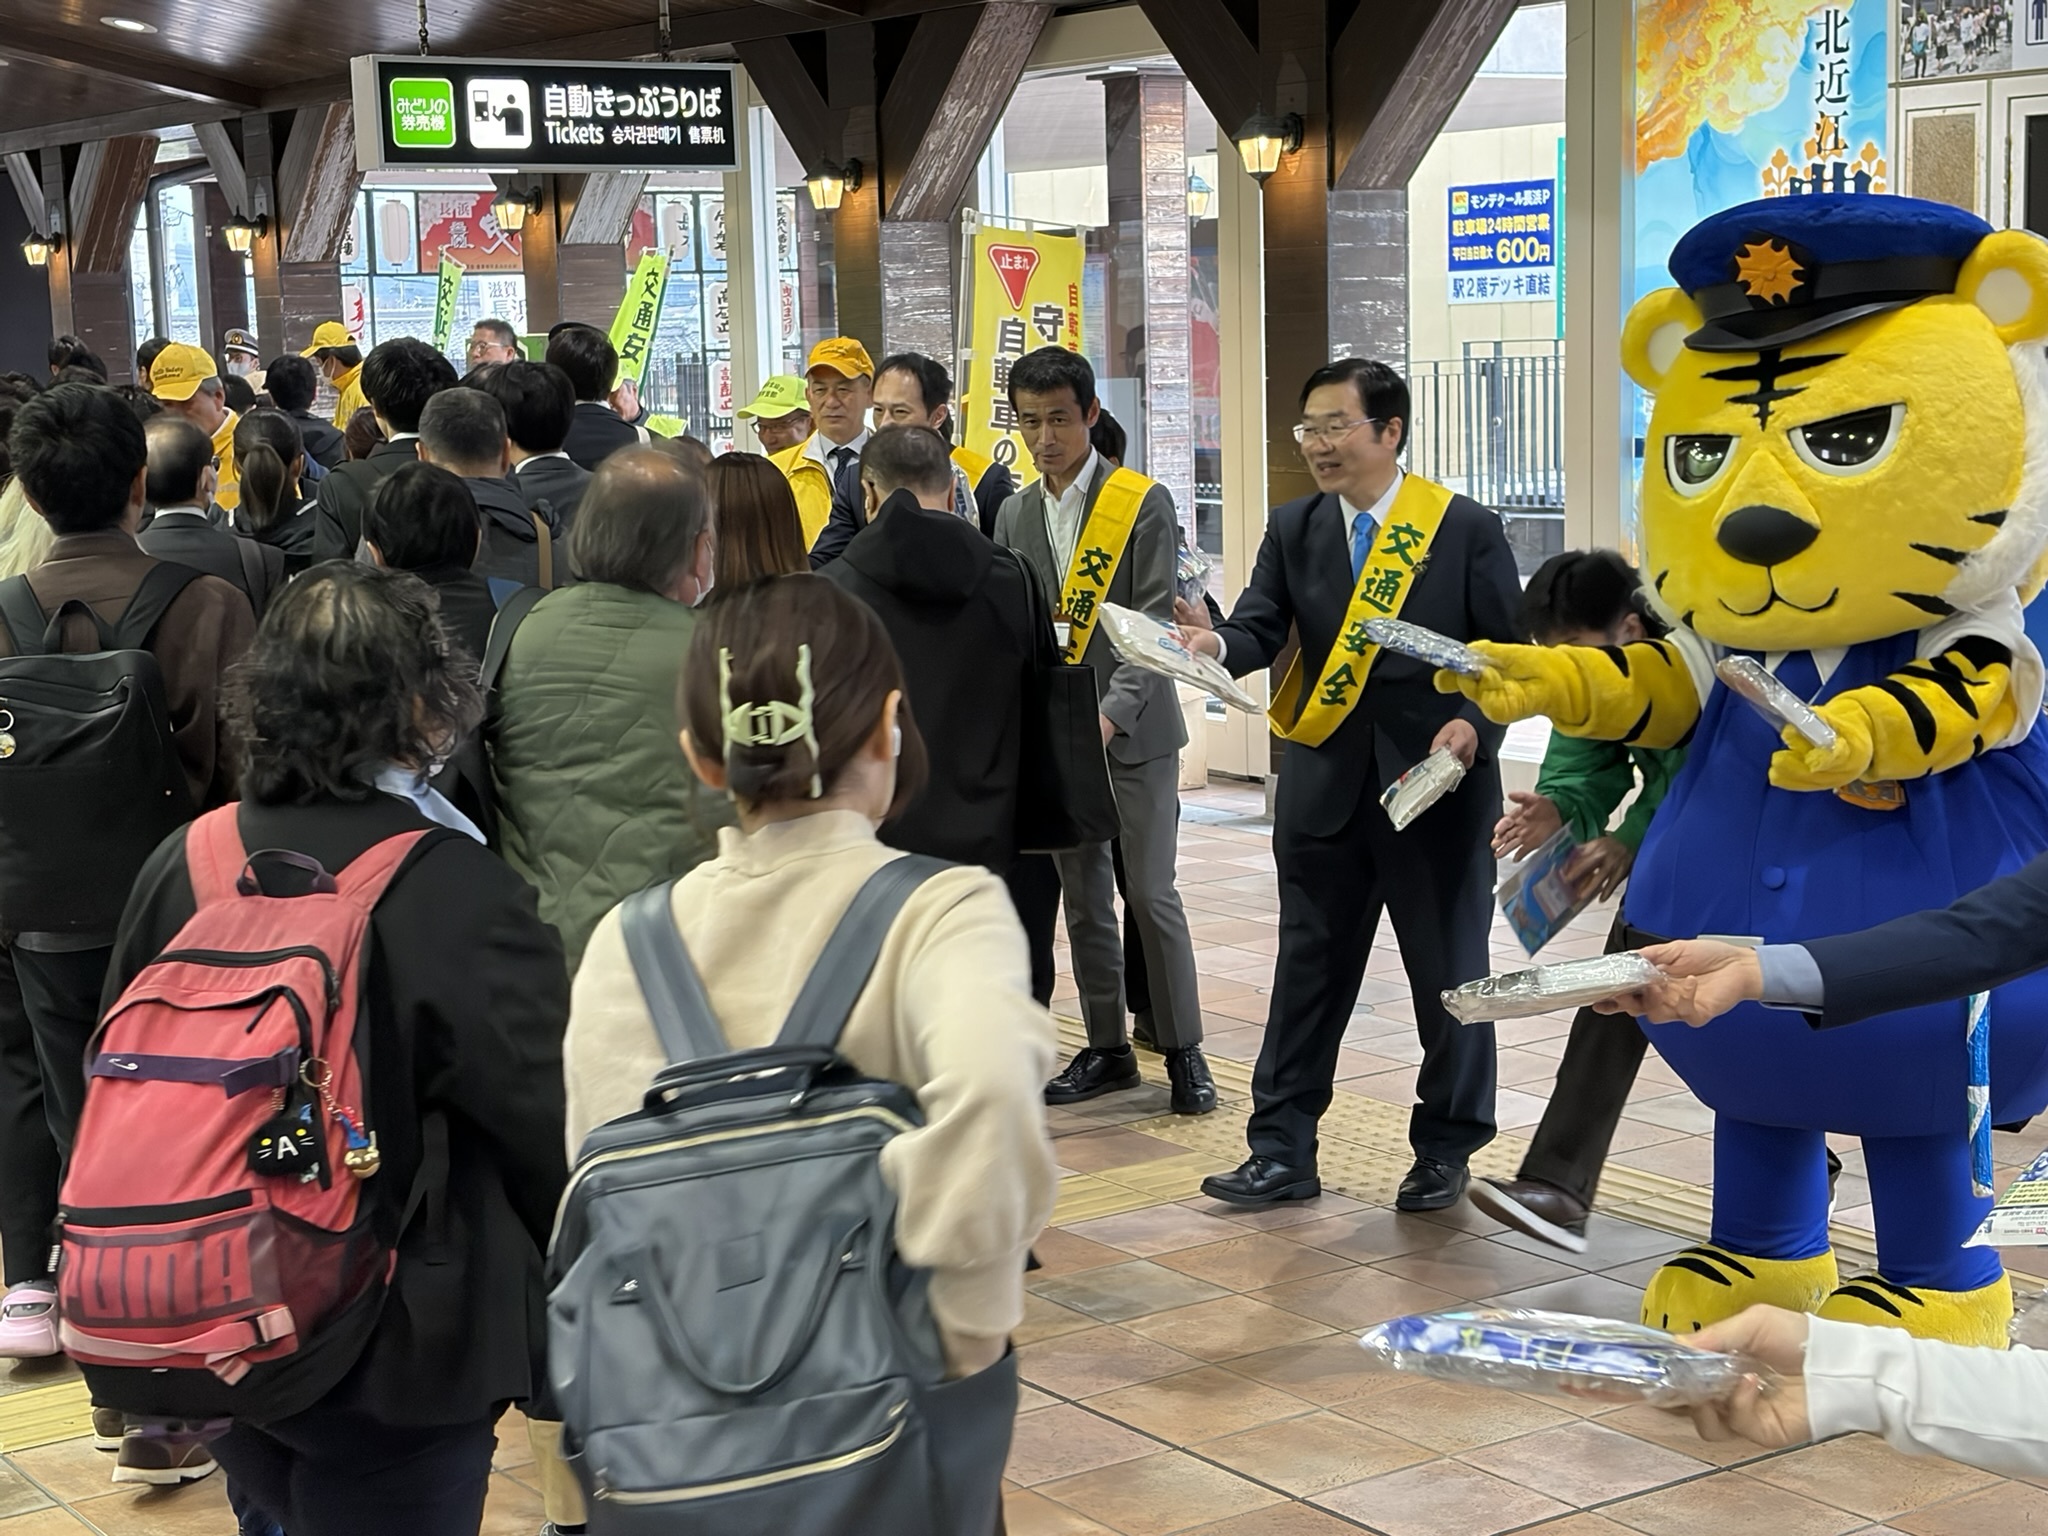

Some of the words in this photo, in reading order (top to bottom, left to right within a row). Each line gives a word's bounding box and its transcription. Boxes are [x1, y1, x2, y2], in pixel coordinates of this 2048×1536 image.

[1814, 8, 1851, 155] 北近江
[396, 97, 449, 115] みどりの
[544, 83, 722, 119] 自動きっぷうりば
[401, 114, 446, 132] 券売機
[544, 120, 605, 145] Tickets
[611, 125, 682, 145] 승차권판매기
[688, 126, 726, 145] 售票机
[1452, 213, 1550, 237] 駐車場24時間営業
[1000, 253, 1030, 271] 止まれ
[1496, 236, 1551, 264] 600円
[1452, 272, 1551, 299] 駅2階デッキ直結
[1063, 546, 1113, 663] 交通
[1320, 522, 1426, 707] 交通安全
[277, 1135, 299, 1160] A
